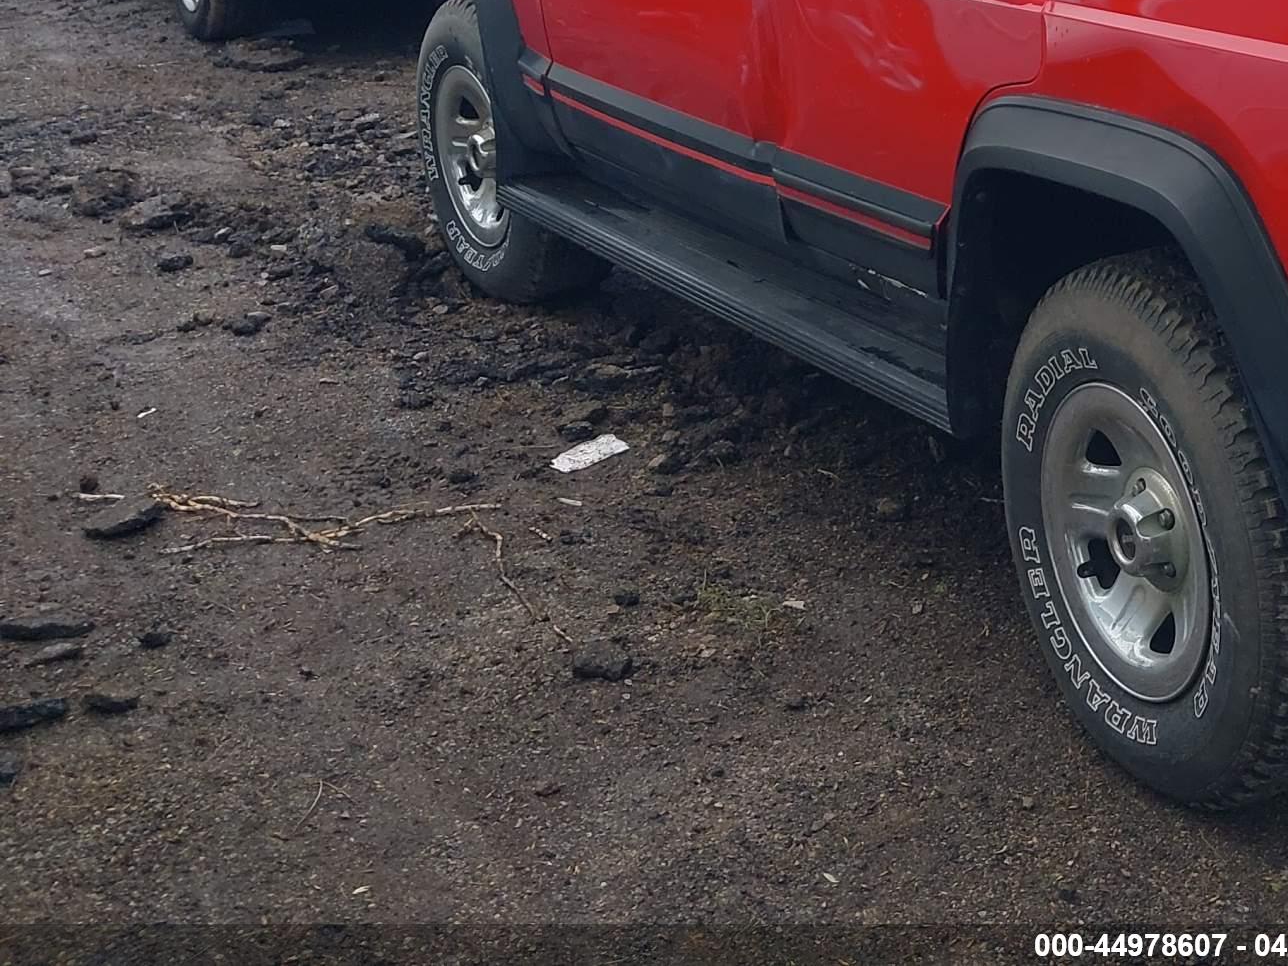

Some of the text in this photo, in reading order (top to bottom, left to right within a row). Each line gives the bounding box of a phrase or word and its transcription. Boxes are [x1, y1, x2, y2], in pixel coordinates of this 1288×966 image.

[420, 44, 449, 181] WRANGLER
[1015, 346, 1098, 452] RADIAL
[1018, 526, 1159, 746] WRANGLER
